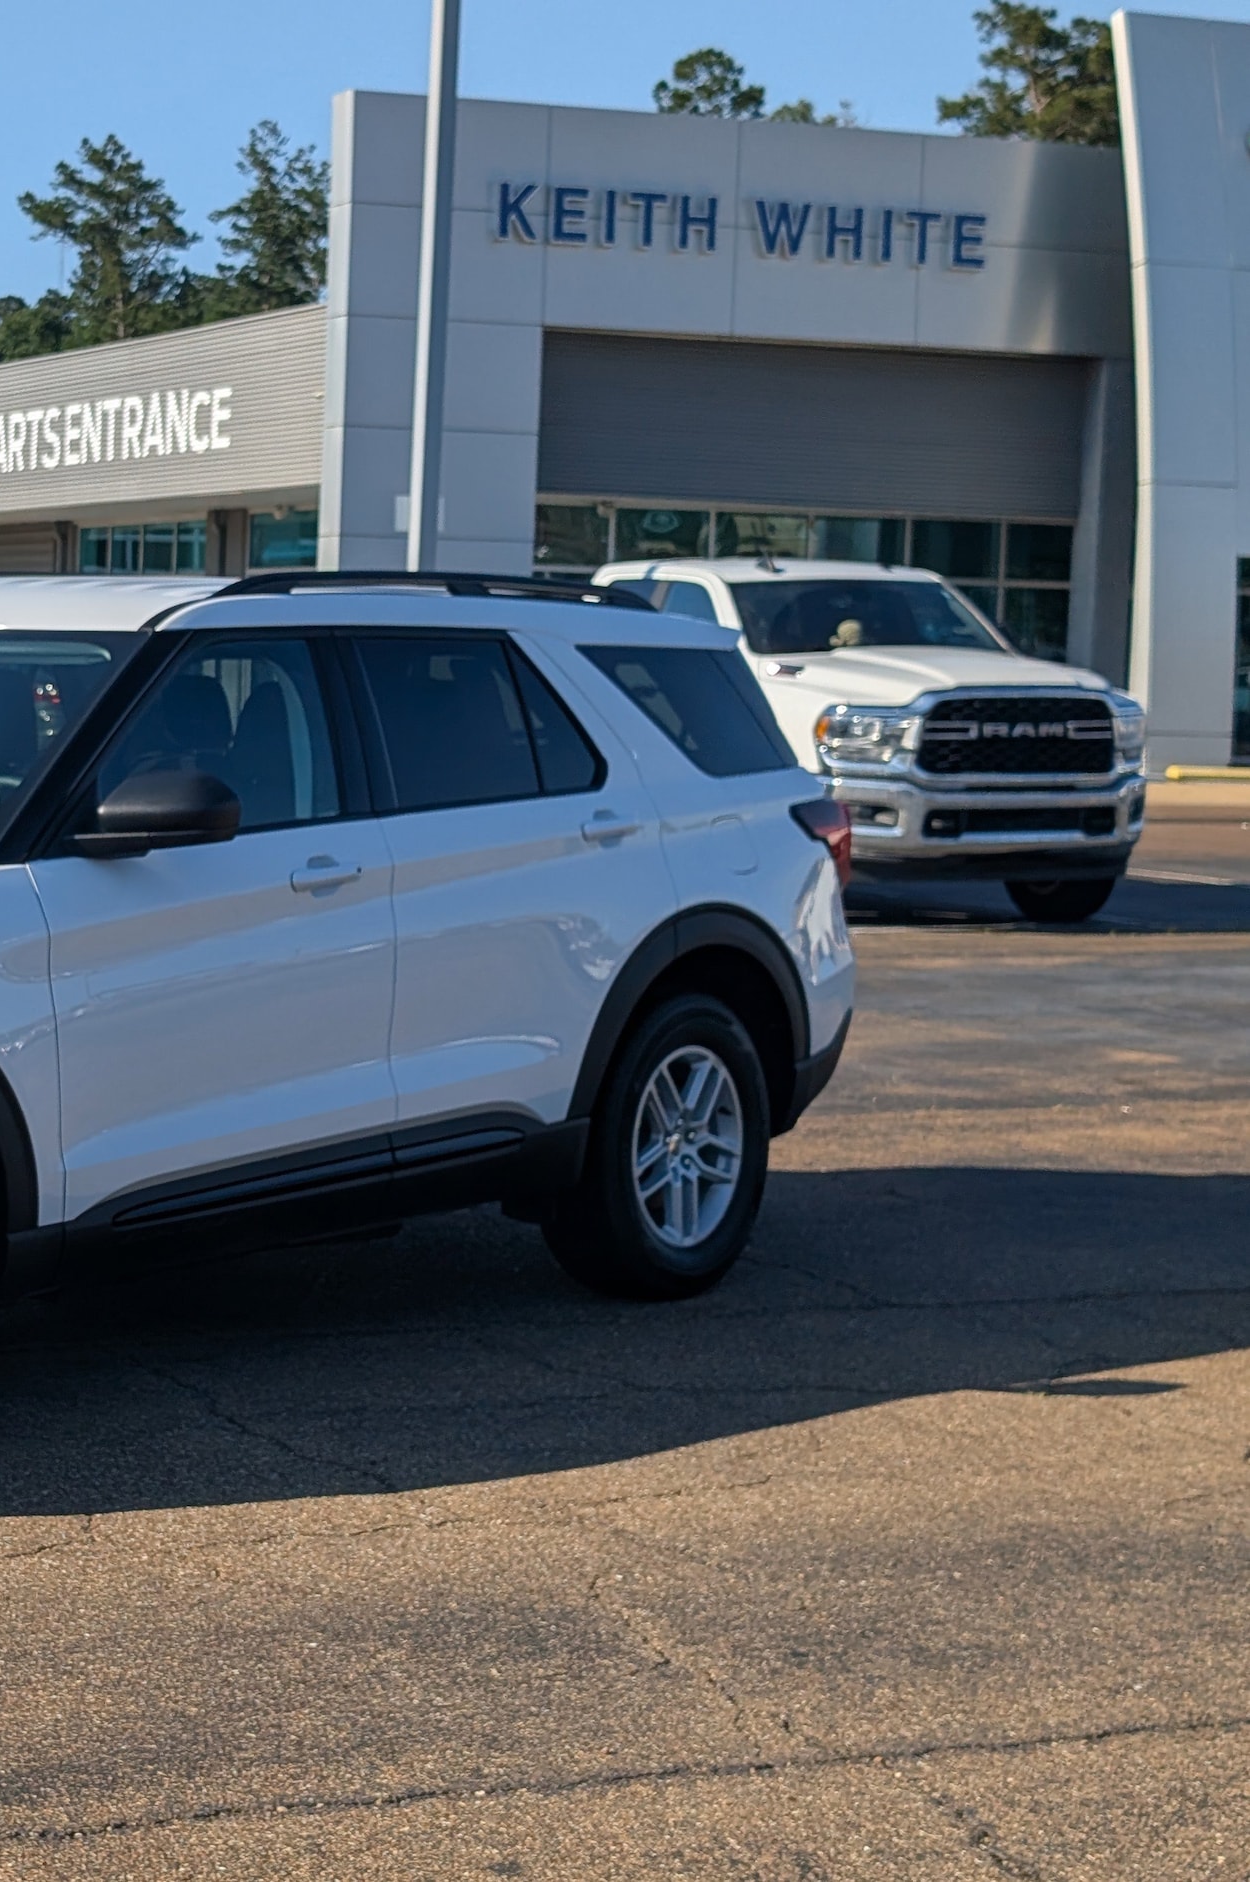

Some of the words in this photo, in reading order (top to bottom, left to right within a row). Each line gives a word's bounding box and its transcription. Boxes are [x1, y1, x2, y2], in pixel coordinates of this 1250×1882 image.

[496, 181, 719, 252] KEITH
[754, 198, 987, 270] WHITE
[64, 386, 233, 468] ENTRANCE
[982, 721, 1064, 739] RAM
